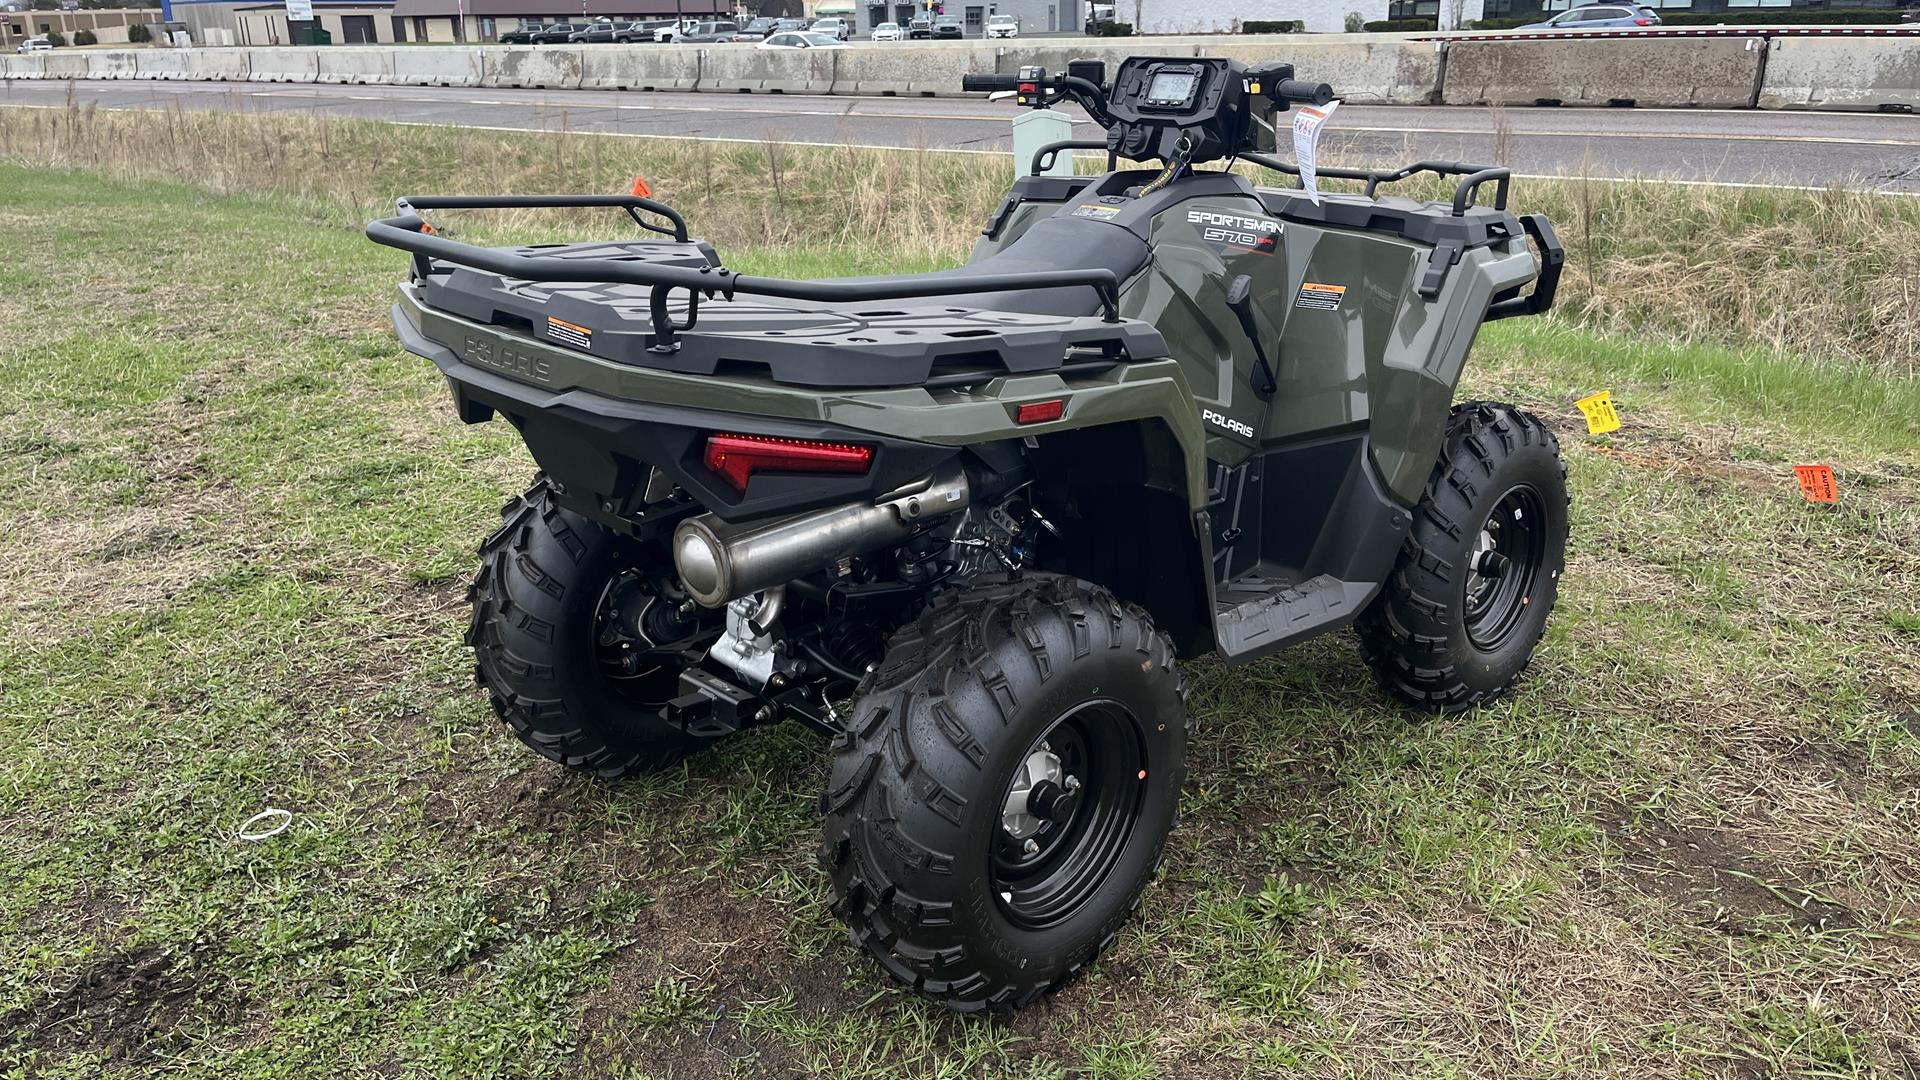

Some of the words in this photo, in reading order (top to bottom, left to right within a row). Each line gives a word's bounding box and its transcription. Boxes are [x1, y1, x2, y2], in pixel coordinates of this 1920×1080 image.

[1187, 210, 1284, 234] SPORTSMAN
[1203, 228, 1257, 246] 570
[464, 335, 551, 382] POLARIS
[1202, 408, 1254, 438] POLARIS
[1821, 470, 1832, 499] CAUTION
